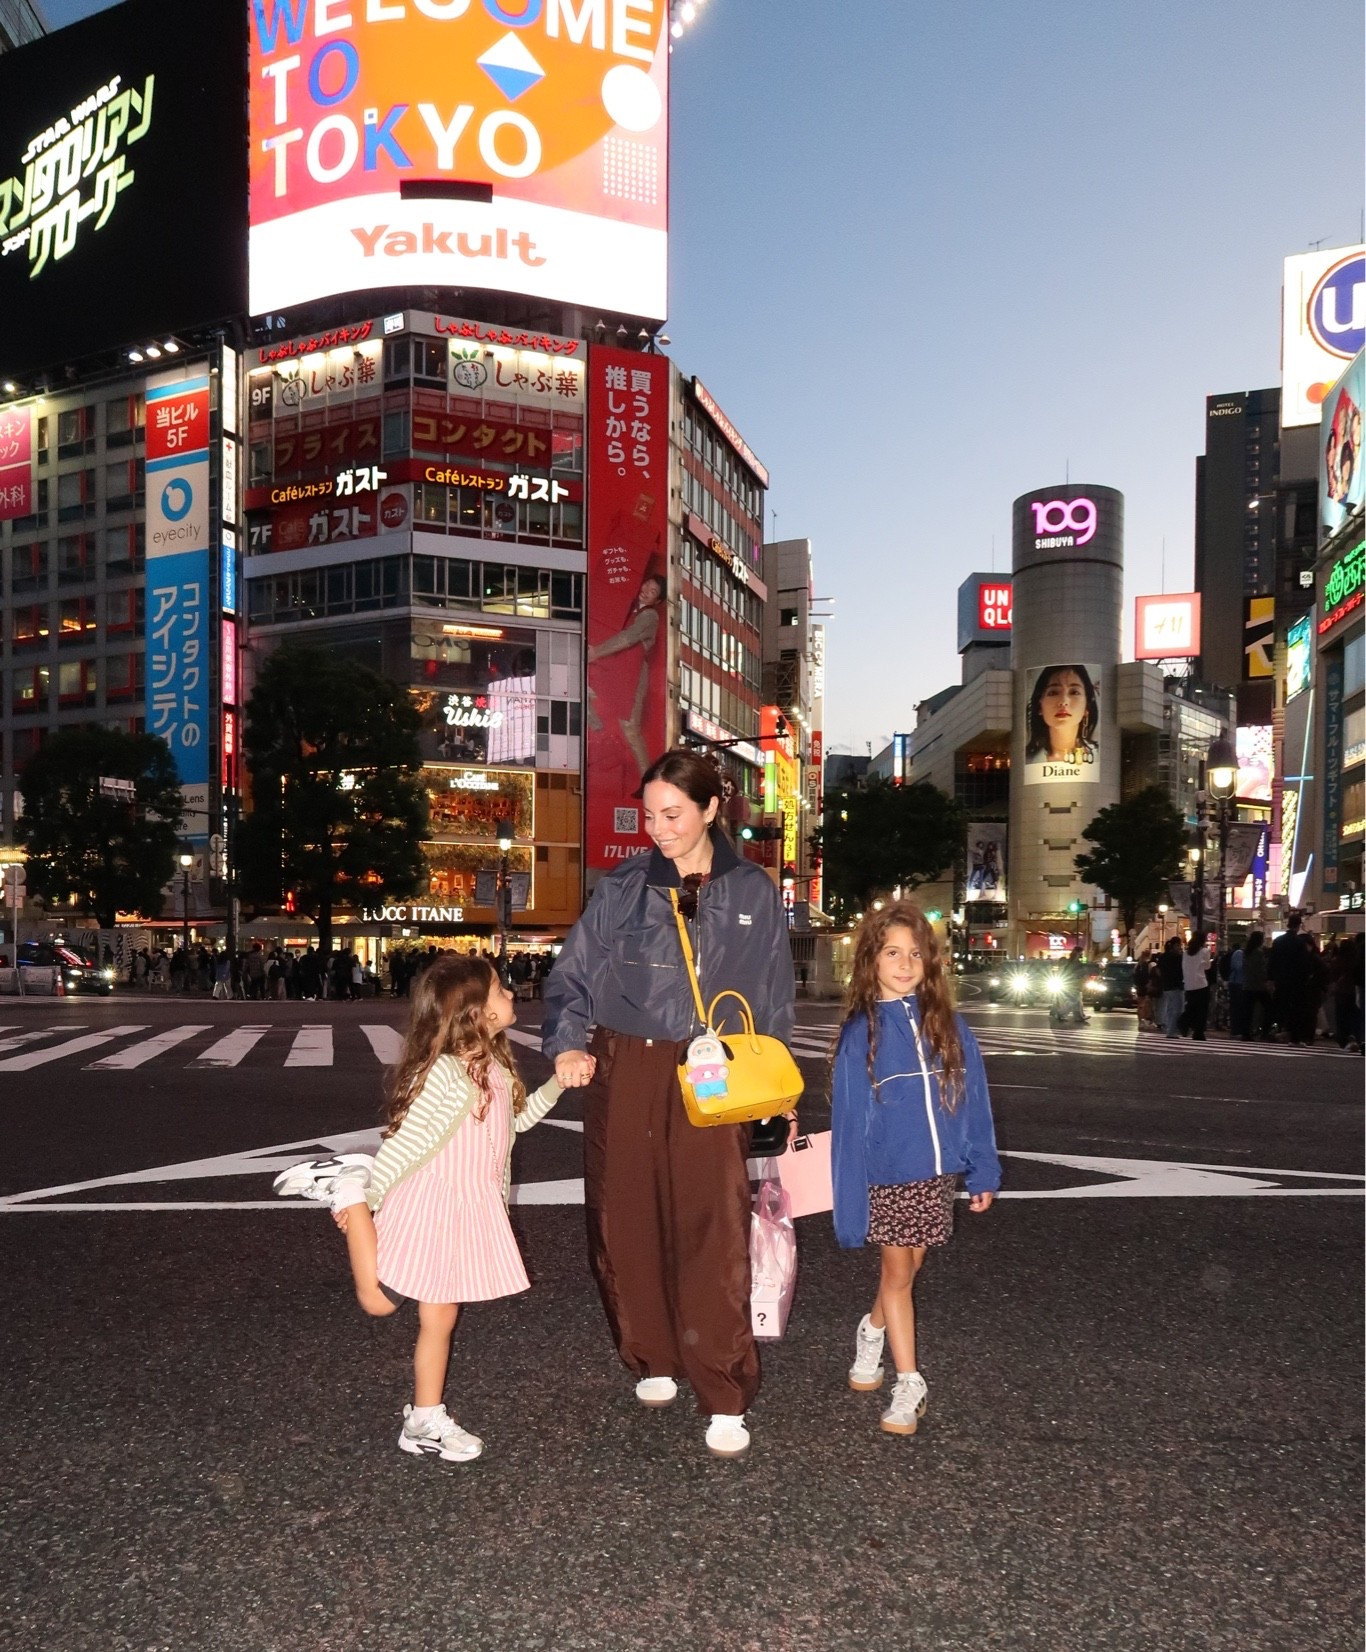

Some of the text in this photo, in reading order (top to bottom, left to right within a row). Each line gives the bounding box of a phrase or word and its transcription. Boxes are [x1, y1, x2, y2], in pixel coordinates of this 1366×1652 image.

[262, 38, 360, 126] TO
[21, 75, 121, 164] STAR WARS
[261, 103, 543, 198] TOKYO
[350, 222, 547, 267] Yakult
[259, 320, 373, 364] しゃぶしゃぶバイキング
[434, 315, 580, 355] しゃぶしゃぶバイキング
[311, 357, 376, 395] しゃぶ葉
[495, 360, 579, 397] しゃぶ葉
[252, 386, 271, 406] 9F
[1210, 407, 1242, 416] INDIGO
[156, 402, 199, 428] 当ビル
[605, 365, 627, 476] 推しから。
[631, 369, 652, 479] 買うなら、
[166, 426, 189, 448] 5F
[414, 416, 546, 457] コンタクト
[335, 466, 388, 497] ガスト
[508, 474, 569, 503] ガスト
[308, 505, 371, 544] ガスト
[384, 506, 405, 519] ガスト
[1031, 498, 1097, 545] 109
[153, 524, 201, 547] eyecity
[250, 524, 272, 546] 7F
[1035, 536, 1074, 549] SHIBUYA
[984, 589, 1008, 606] UN
[152, 585, 178, 750] アイシティ
[182, 582, 200, 747] コンタクトの
[184, 795, 205, 803] Lens
[604, 845, 648, 858] 17LIVE
